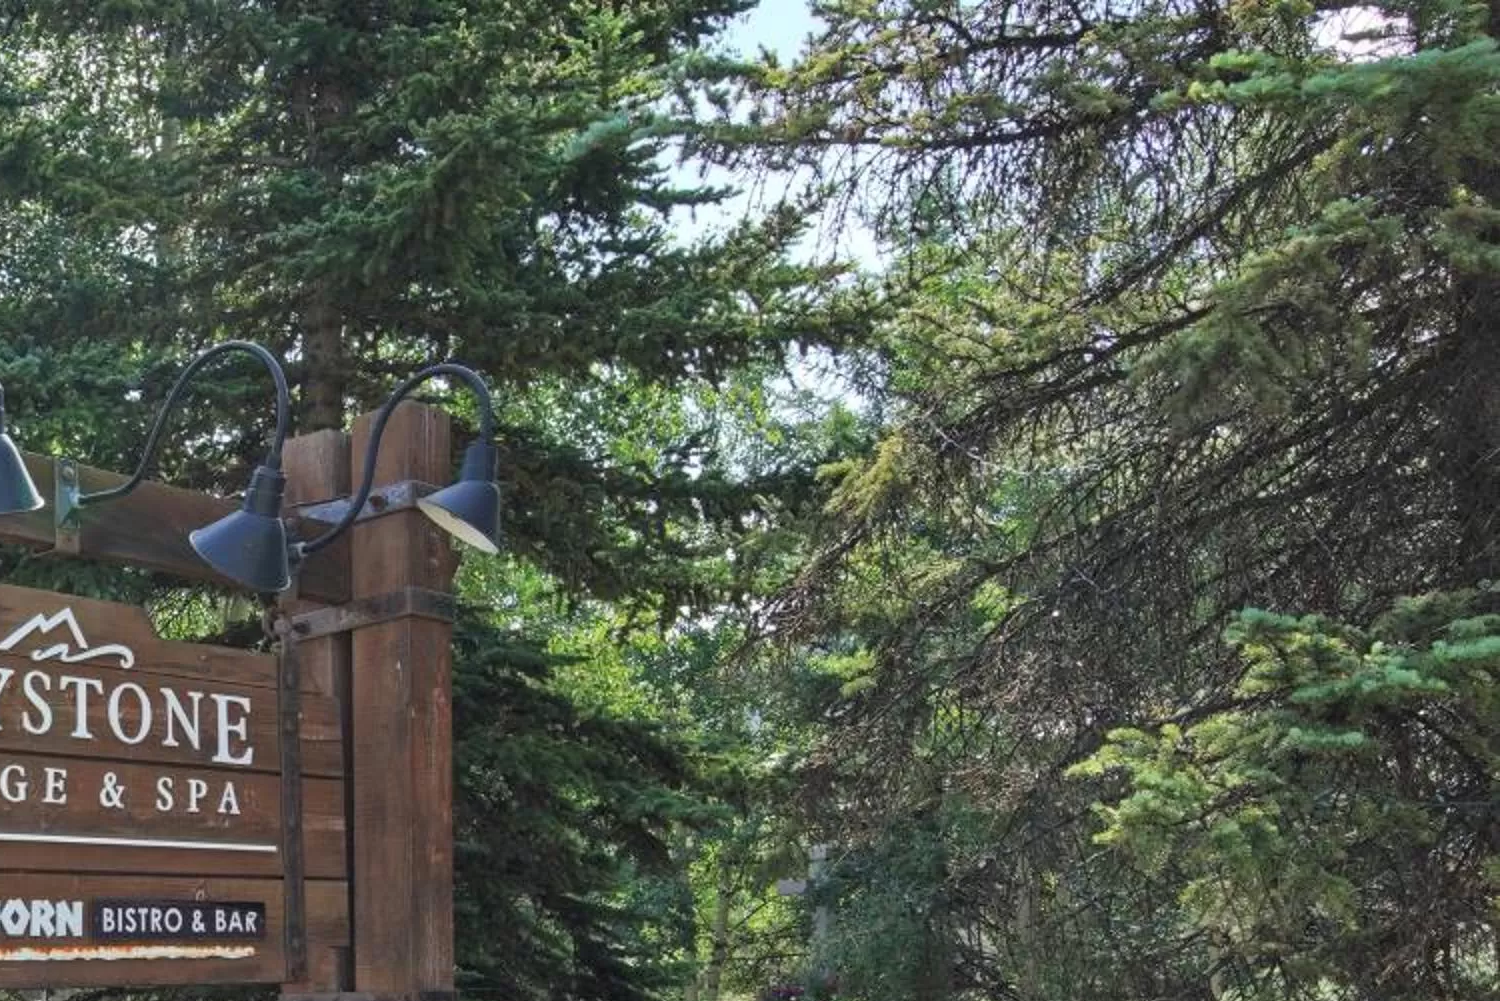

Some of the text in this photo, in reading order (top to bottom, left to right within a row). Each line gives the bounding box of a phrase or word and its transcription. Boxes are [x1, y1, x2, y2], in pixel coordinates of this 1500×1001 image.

[99, 771, 125, 809] &
[156, 776, 241, 815] SPA
[102, 907, 183, 933] BISTRO
[191, 909, 206, 933] &
[215, 909, 257, 933] BAR
